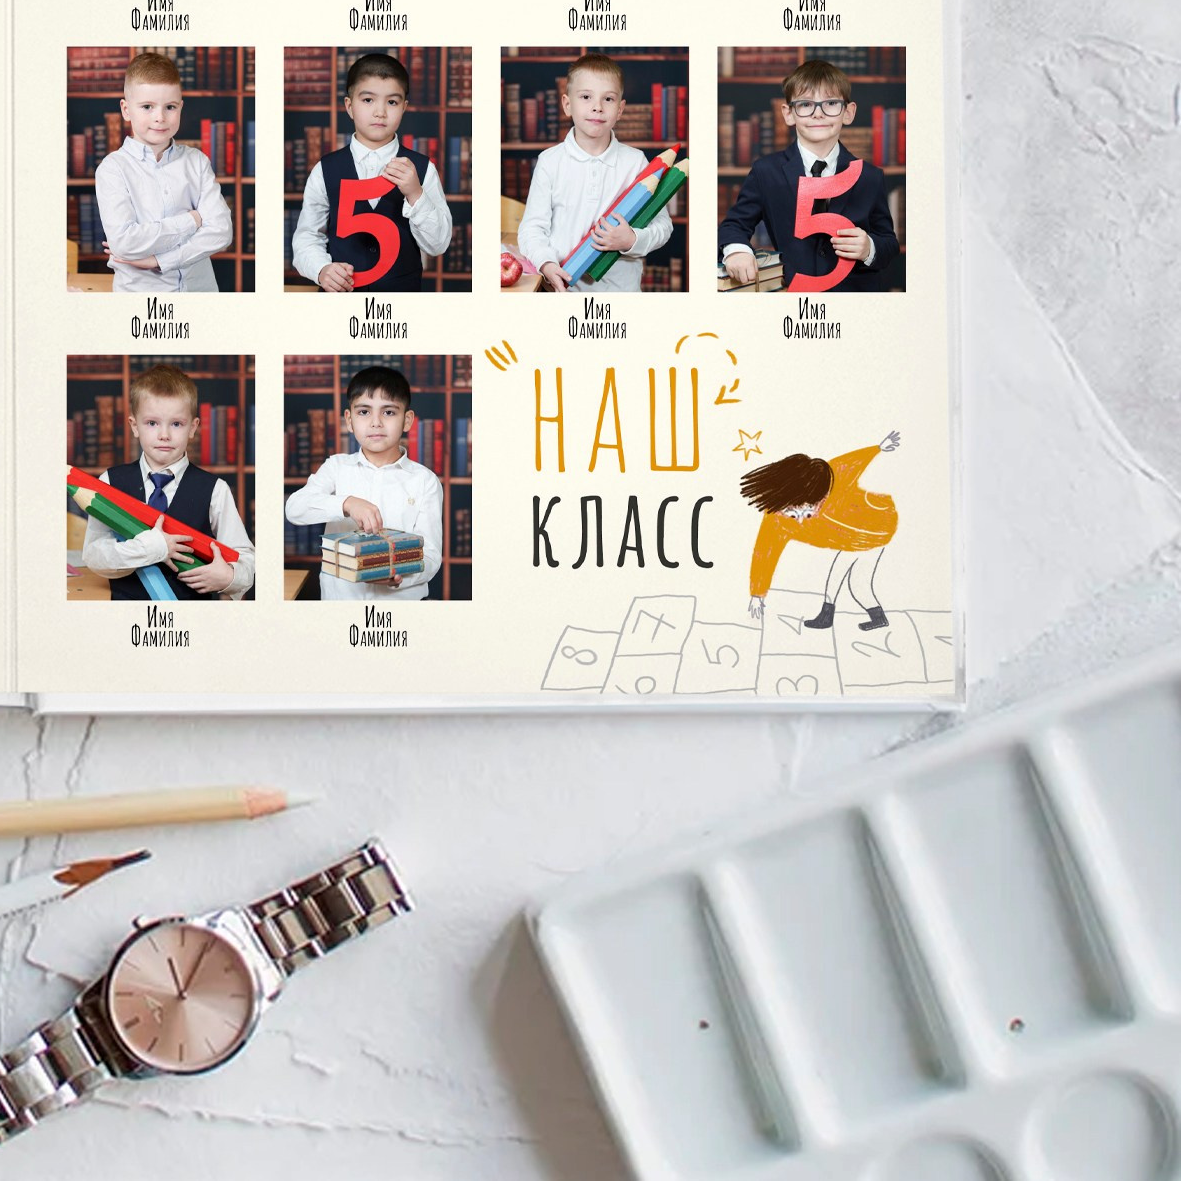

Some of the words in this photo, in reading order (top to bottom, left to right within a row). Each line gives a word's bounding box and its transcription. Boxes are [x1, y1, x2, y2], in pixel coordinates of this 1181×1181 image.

[131, 6, 190, 32] Фамилия
[349, 7, 408, 32] Фамилия
[568, 7, 627, 32] Фамилия
[783, 6, 841, 32] Фамилия
[336, 174, 401, 288] 5
[787, 158, 863, 292] 5
[147, 296, 174, 321] Имя
[365, 296, 392, 321] Имя
[584, 296, 611, 321] Имя
[798, 296, 826, 321] Имя
[131, 315, 190, 340] Фамилия
[349, 315, 408, 340] Фамилия
[568, 315, 627, 340] Фамилия
[783, 315, 841, 340] Фамилия
[534, 367, 700, 473] НАШ
[532, 495, 714, 570] КЛАСС
[147, 604, 174, 629] Имя
[365, 604, 392, 629] Имя
[632, 609, 676, 643] 7
[131, 623, 190, 648] Фамилия
[349, 623, 408, 648] Фамилия
[851, 631, 902, 658] 2
[561, 645, 598, 666] 8
[701, 639, 739, 668] 5
[776, 674, 818, 695] 3
